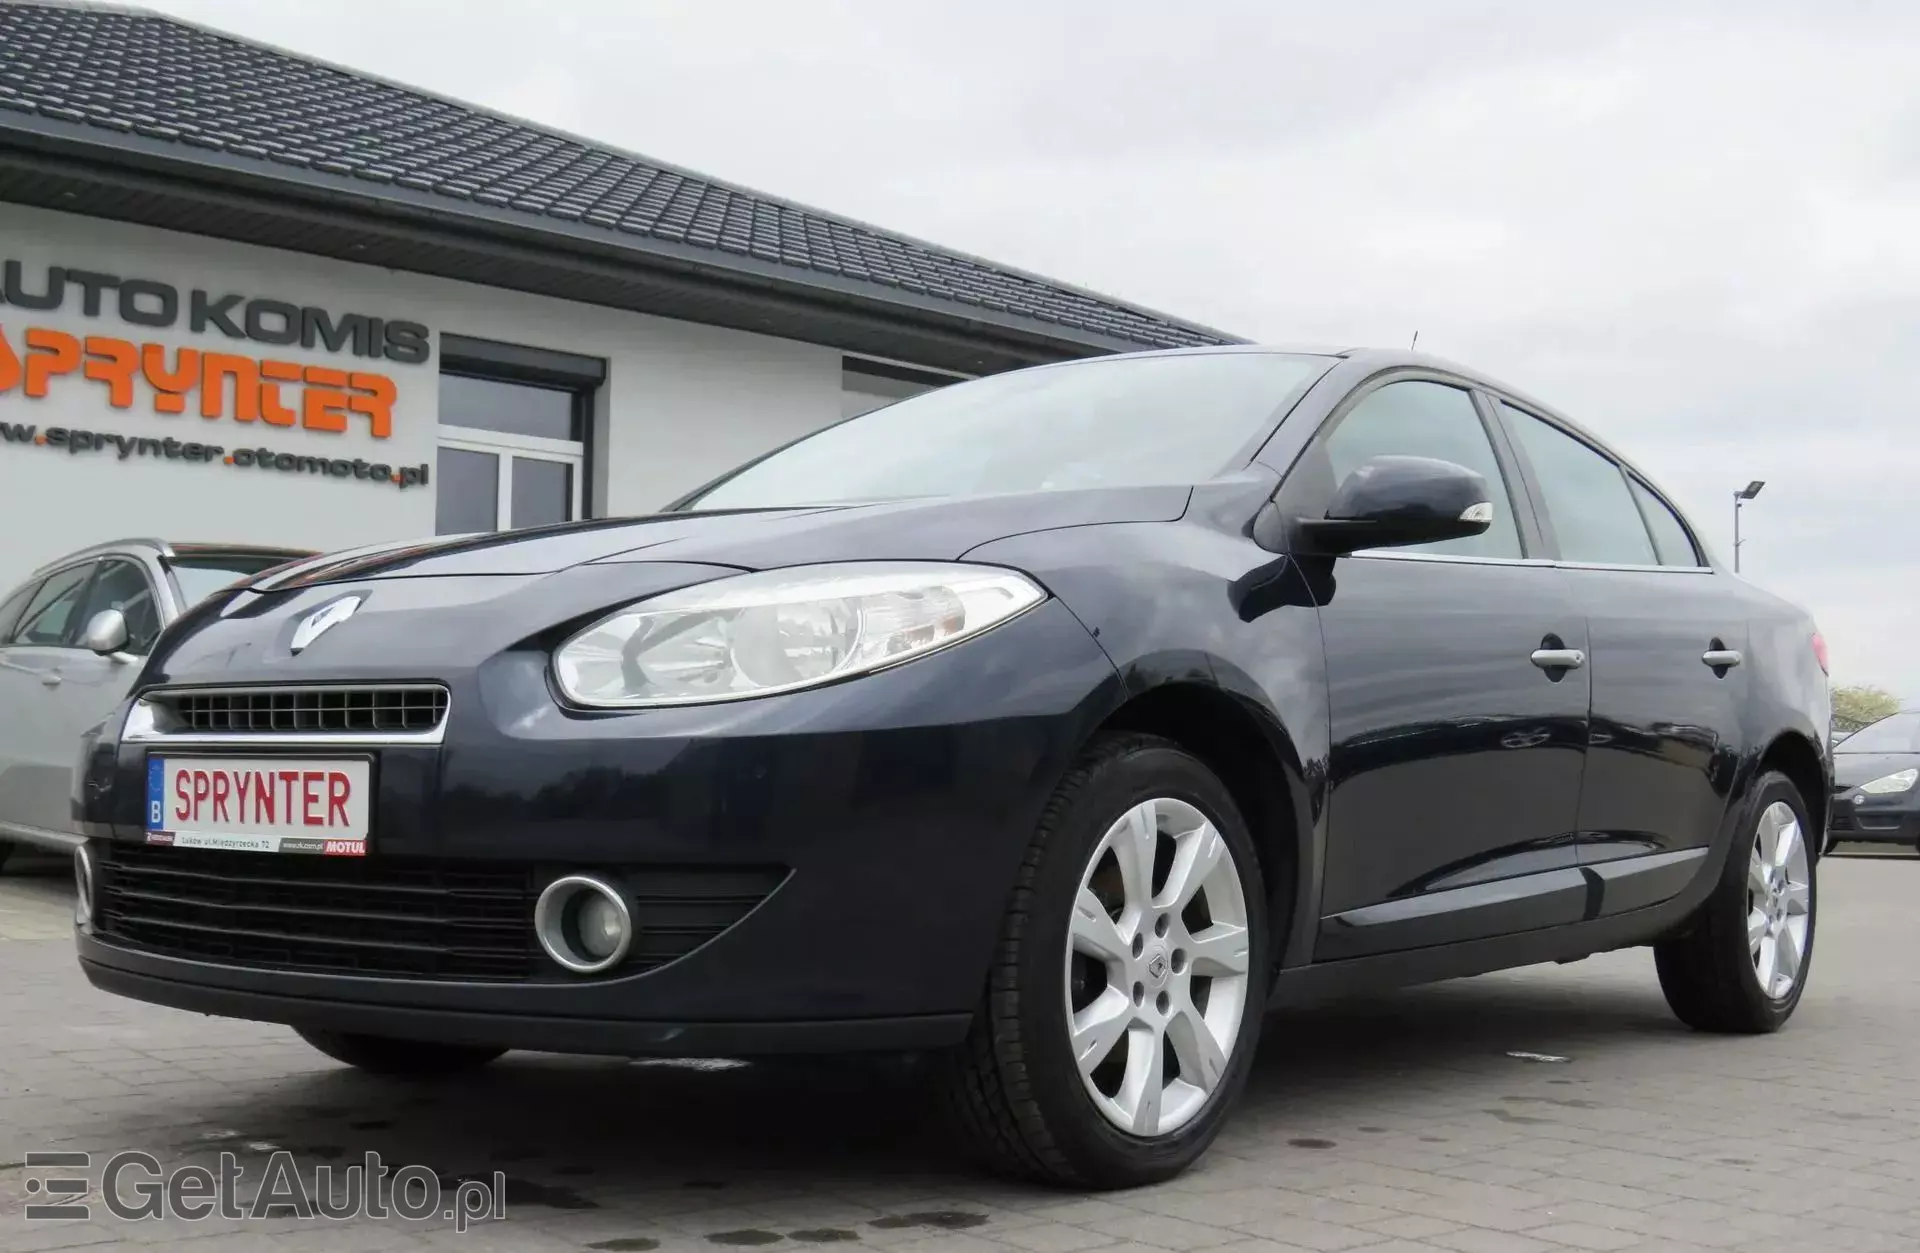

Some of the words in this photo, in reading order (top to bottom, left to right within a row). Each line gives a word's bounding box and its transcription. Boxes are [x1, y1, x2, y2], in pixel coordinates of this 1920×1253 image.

[0, 260, 178, 328] UTO
[190, 289, 430, 364] KOMIS
[151, 800, 161, 823] B
[175, 769, 351, 827] SPRYNTER
[326, 841, 366, 853] MOTUL
